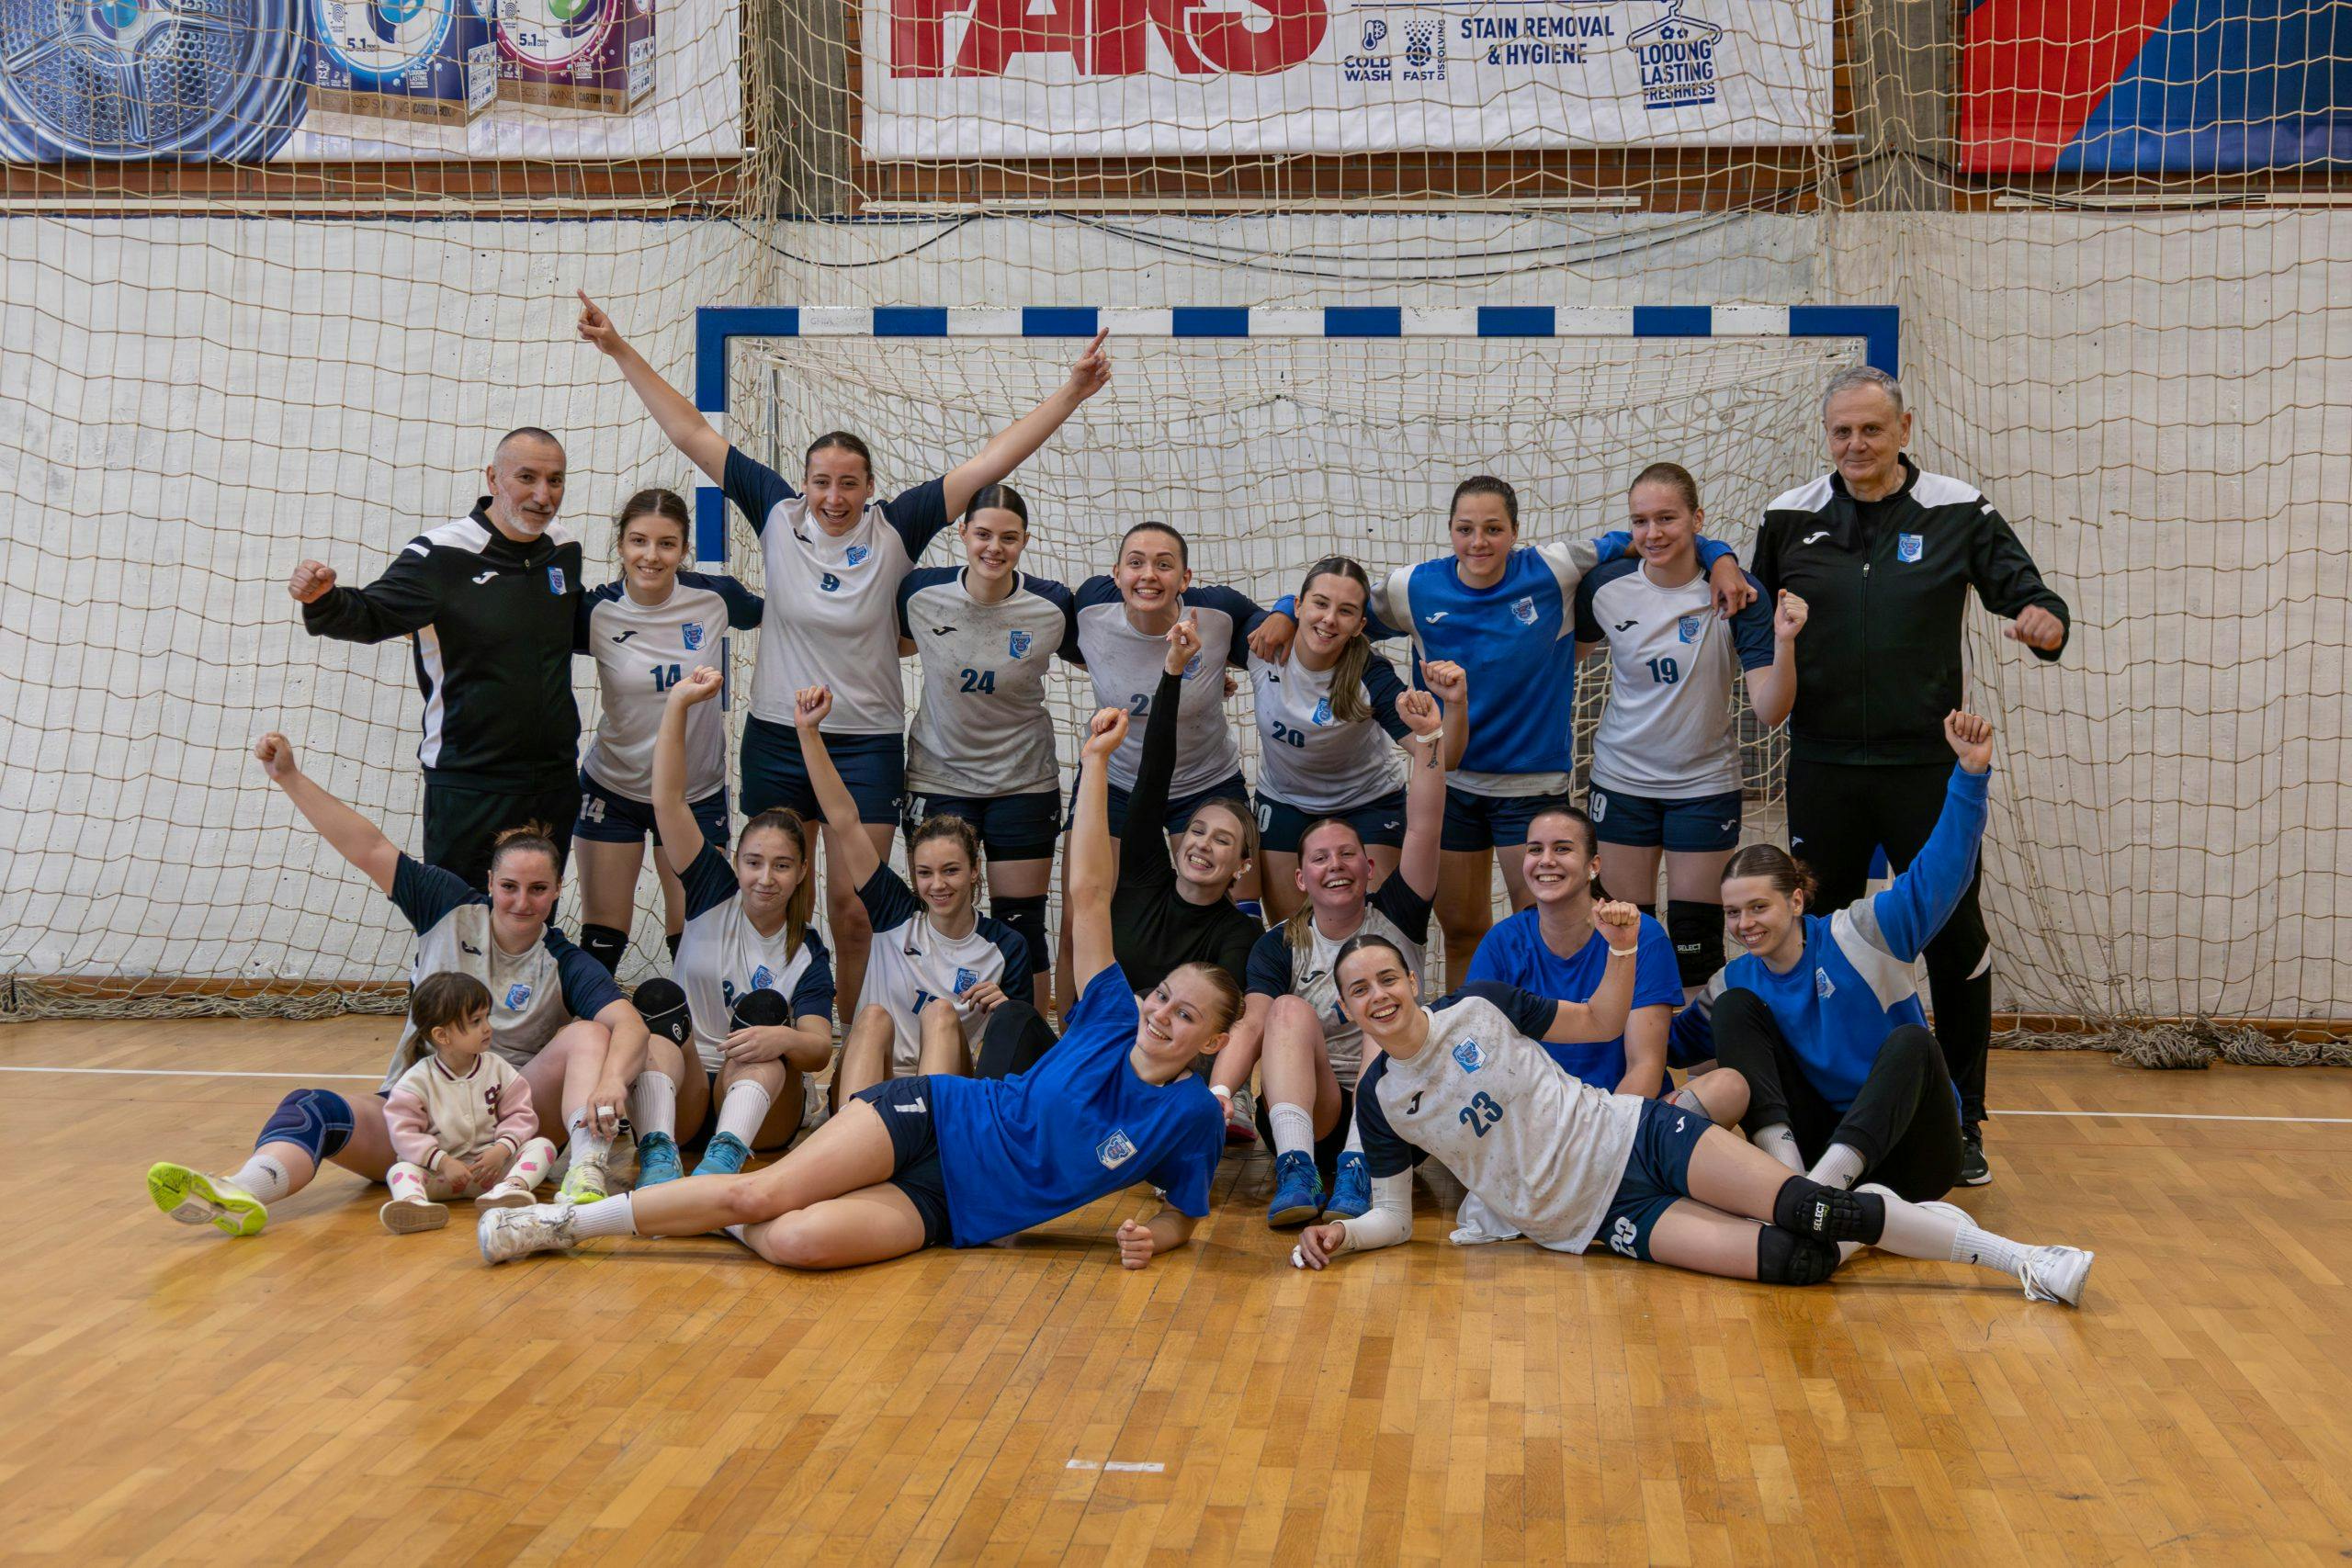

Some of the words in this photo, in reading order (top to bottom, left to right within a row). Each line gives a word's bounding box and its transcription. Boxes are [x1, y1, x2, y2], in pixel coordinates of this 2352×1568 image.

[1461, 17, 1514, 39] STAIN
[1524, 16, 1615, 38] REMOVAL
[1344, 55, 1391, 69] COLD
[1437, 18, 1446, 81] DISSOLVING
[1487, 46, 1500, 65] &
[1506, 44, 1588, 65] HYGIENE
[1639, 39, 1712, 66] LOOONG
[1345, 71, 1392, 81] WASH
[1403, 71, 1435, 81] FAST
[1641, 61, 1713, 86] LASTING
[1644, 82, 1715, 101] FRESHNESS
[650, 664, 682, 692] 14
[960, 668, 995, 695] 24
[1645, 657, 1679, 685] 19
[1131, 694, 1154, 716] 2
[1272, 721, 1305, 748] 20
[580, 793, 605, 824] 14
[1588, 791, 1608, 822] 19
[912, 989, 939, 1015] 1
[1459, 1090, 1504, 1139] 23
[1814, 1201, 1826, 1232] SELECT
[1610, 1215, 1640, 1259] 23
